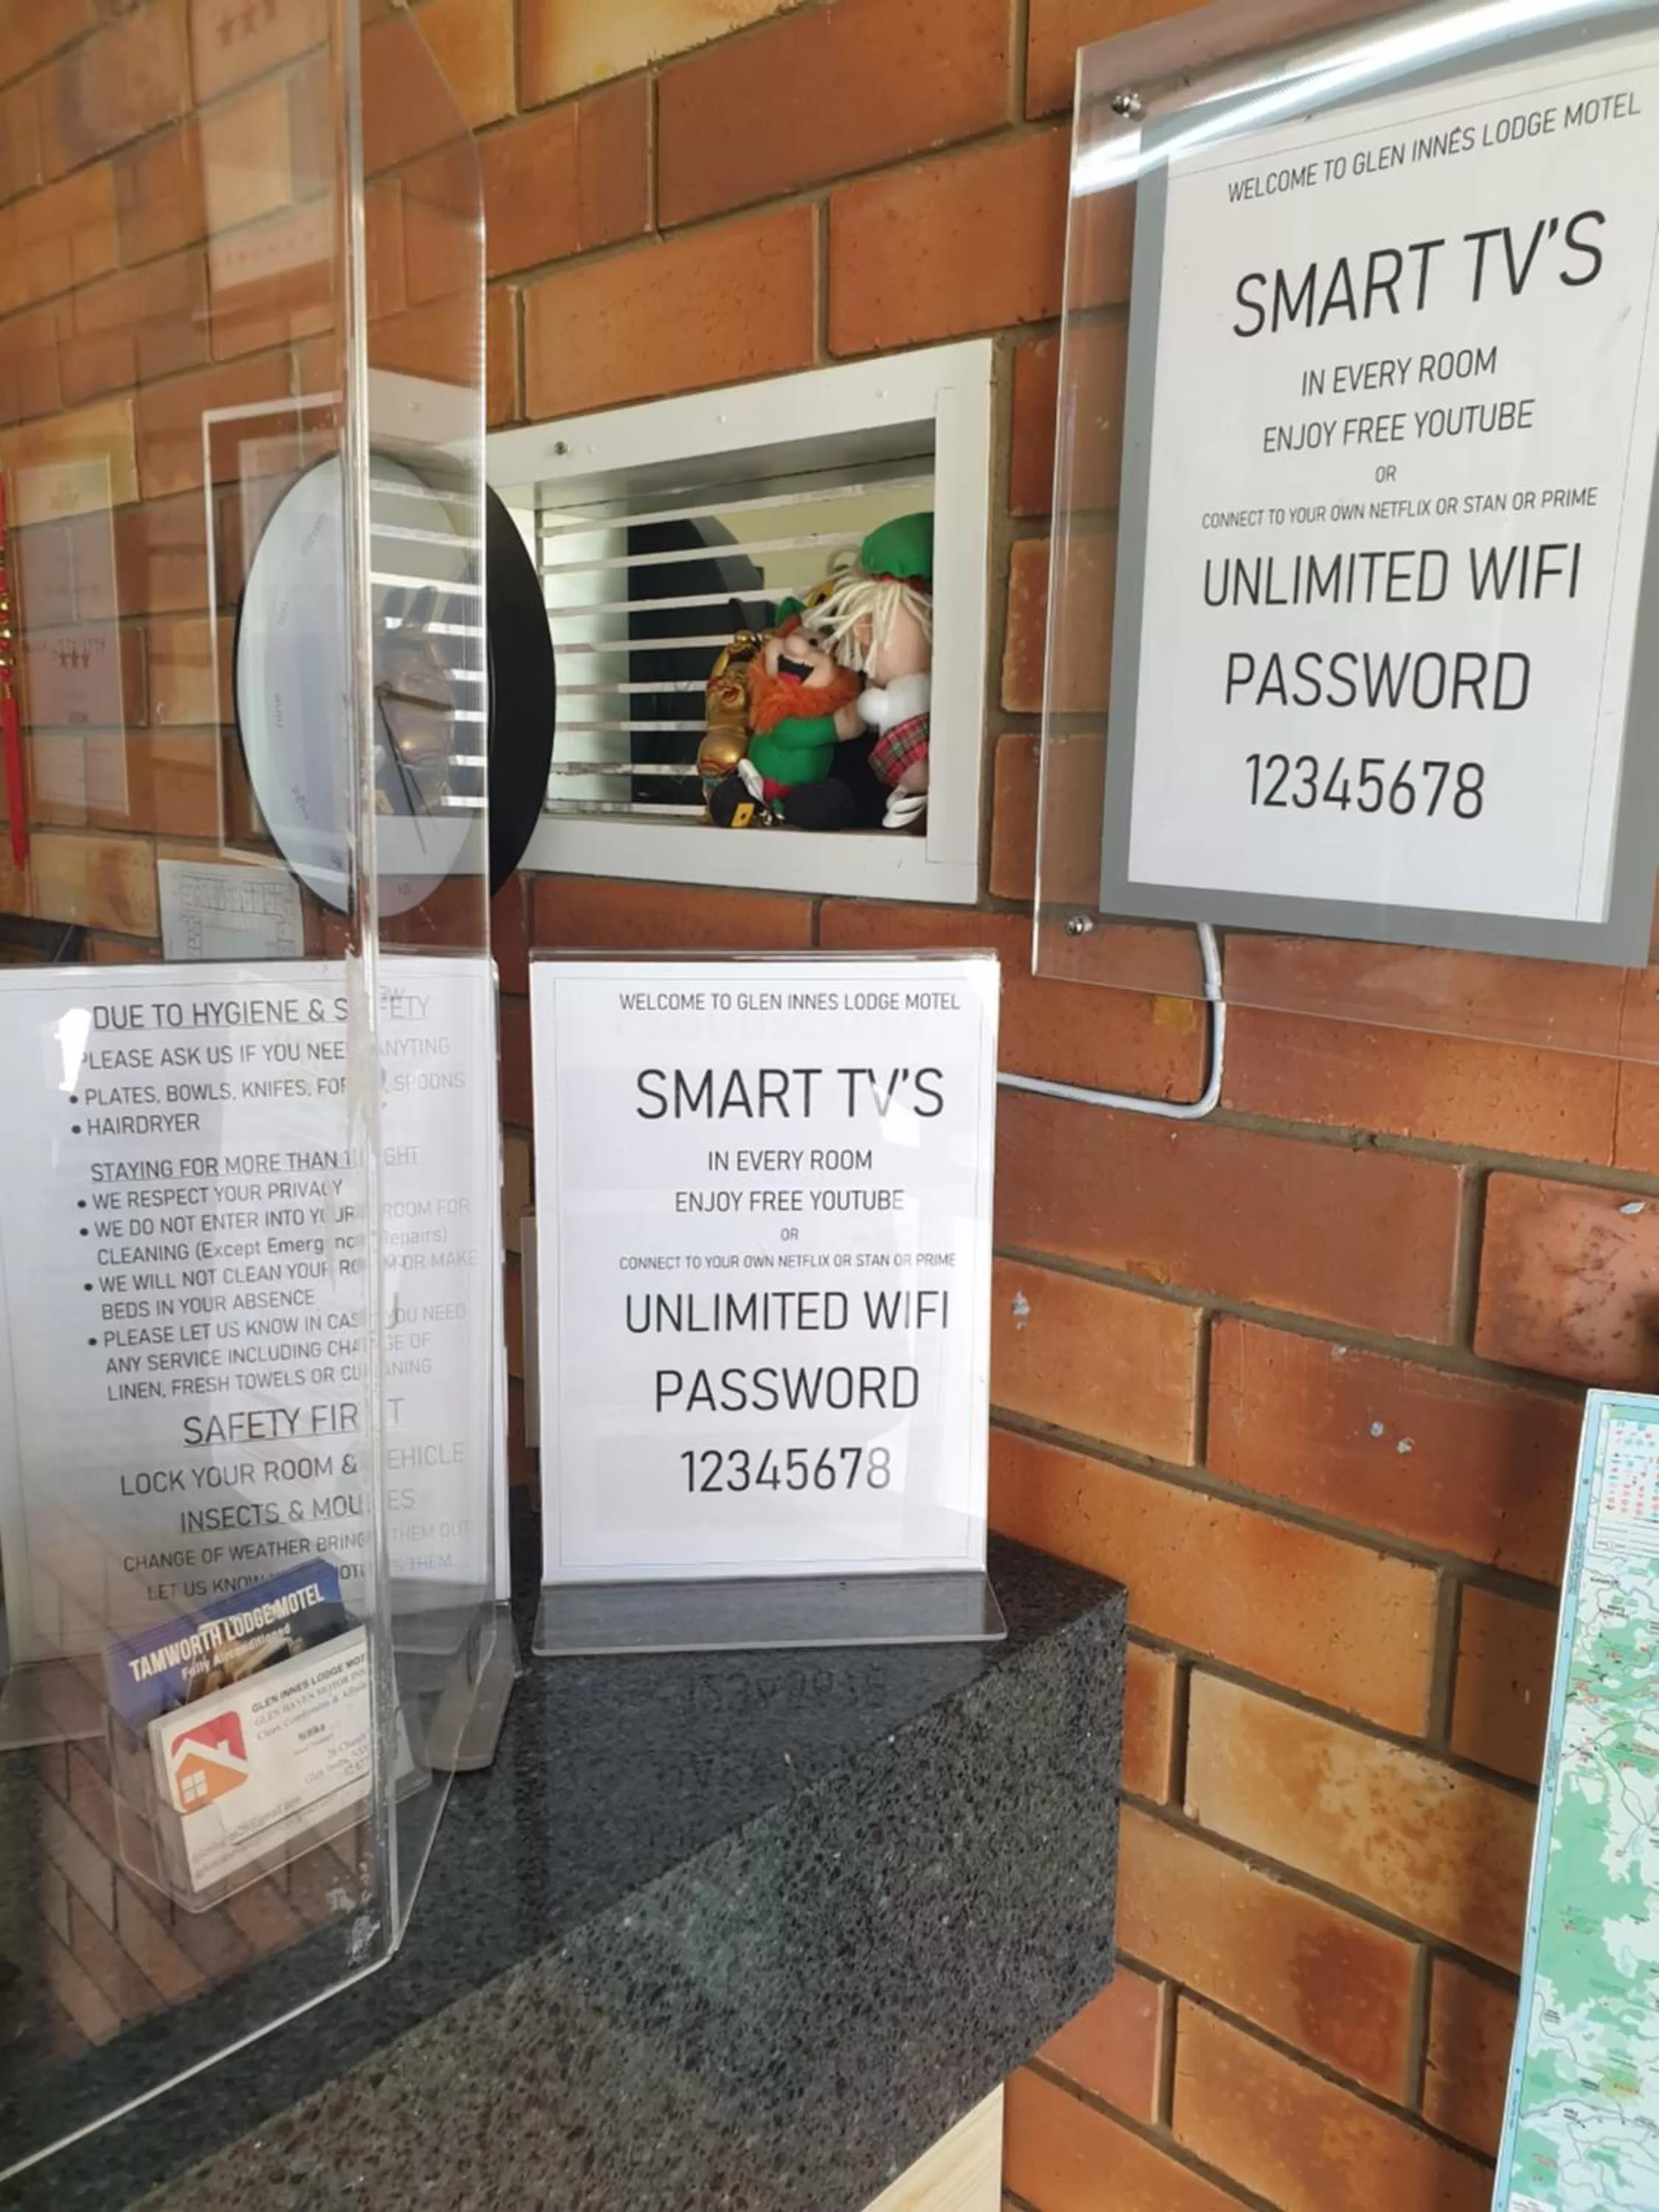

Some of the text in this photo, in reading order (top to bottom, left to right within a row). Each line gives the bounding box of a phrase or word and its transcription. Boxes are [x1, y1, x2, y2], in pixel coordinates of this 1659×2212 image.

[1228, 162, 1318, 204] WELCOME
[1324, 156, 1347, 183] TO
[1352, 142, 1406, 175] GLEN
[1481, 107, 1558, 147] LODGE
[1563, 91, 1641, 129] MOTEL
[1233, 209, 1606, 338] SMART TV'S
[1301, 345, 1498, 397] IN EVERY ROOM
[1263, 398, 1536, 453] ENJOY FREE YOUTUBE
[1375, 464, 1397, 484] OR
[1201, 486, 1599, 530] CONNECT TO YOUR OWN NETFLIX OR STAN OR PRIME
[1203, 542, 1582, 607] UNLIMITED WIFI
[1225, 651, 1530, 711] PASSWORD
[1245, 753, 1484, 820] 12345678
[93, 995, 430, 1029] DUE TO HYGIENE & SETY
[619, 992, 961, 1011] WELCOME TO GLEN INNES LODGE MOTEL
[161, 1047, 201, 1066] ASK
[207, 1045, 233, 1064] US
[240, 1044, 257, 1062] IF
[262, 1043, 300, 1062] YOU
[307, 1040, 345, 1060] NEE
[378, 1037, 450, 1057] NYTING
[85, 1085, 161, 1106] PLATES,
[393, 1072, 466, 1091] SPOONS
[636, 1067, 944, 1120] SMART TV'S
[86, 1113, 201, 1135] HAIRDRYER
[91, 1160, 173, 1183] STAYING
[180, 1157, 219, 1178] FOR
[226, 1153, 281, 1173] MORE
[286, 1150, 337, 1170] THAN
[709, 1149, 872, 1172] IN EVERY ROOM
[92, 1192, 122, 1210] WE
[128, 1186, 209, 1208] RESPECT
[215, 1183, 262, 1203] YOUR
[675, 1189, 905, 1213] ENJOY FREE YOUTUBE
[94, 1220, 123, 1238] WE
[129, 1219, 155, 1237] DO
[161, 1216, 195, 1234] NOT
[201, 1211, 259, 1232] ENTER
[265, 1208, 305, 1227] INTO
[437, 1197, 472, 1215] FOR
[780, 1227, 799, 1242] OR
[97, 1243, 190, 1266] CLEANING
[195, 1239, 262, 1259] (Except
[268, 1234, 369, 1256] Emergnc
[619, 1252, 956, 1270] CONNECT TO YOUR OWN NETFLIX OR STAN OR PRIME
[99, 1275, 127, 1293] WE
[133, 1273, 177, 1290] WILL
[182, 1268, 218, 1287] NOT
[223, 1265, 282, 1284] CLEAN
[338, 1255, 400, 1276] ROM
[102, 1289, 315, 1321] BEDS IN YOUR ABSENCE
[104, 1326, 174, 1347] PLEASE
[180, 1324, 210, 1341] LET
[216, 1323, 240, 1339] US
[246, 1318, 299, 1336] KNOW
[305, 1316, 321, 1331] IN
[327, 1312, 378, 1330] CAS
[422, 1302, 466, 1321] NEED
[626, 1290, 948, 1334] UNLIMITED WIFI
[106, 1332, 431, 1374] ANY SERVICE INCLUDING OF
[172, 1378, 229, 1397] FRESH
[236, 1369, 306, 1391] TOWELS
[311, 1367, 335, 1384] OR
[340, 1359, 432, 1381] CLNING
[655, 1366, 919, 1413] PASSWORD
[184, 1398, 405, 1445] SAFETY FIRT
[120, 1442, 466, 1495] LOCK YOUR ROOM & EHICLE
[680, 1447, 891, 1493] 12345678
[181, 1488, 414, 1533] INSECTS & MOUES
[123, 1550, 195, 1571] CHANGE
[201, 1547, 223, 1564] OF
[228, 1538, 310, 1560] WEATHER
[438, 1519, 472, 1537] OUT
[147, 1583, 176, 1601] LET
[184, 1579, 207, 1597] US
[128, 1623, 223, 1682] TAMWORTH
[225, 1601, 274, 1642] LODGE
[273, 1582, 326, 1623] MOTEL
[344, 1653, 367, 1669] MOT
